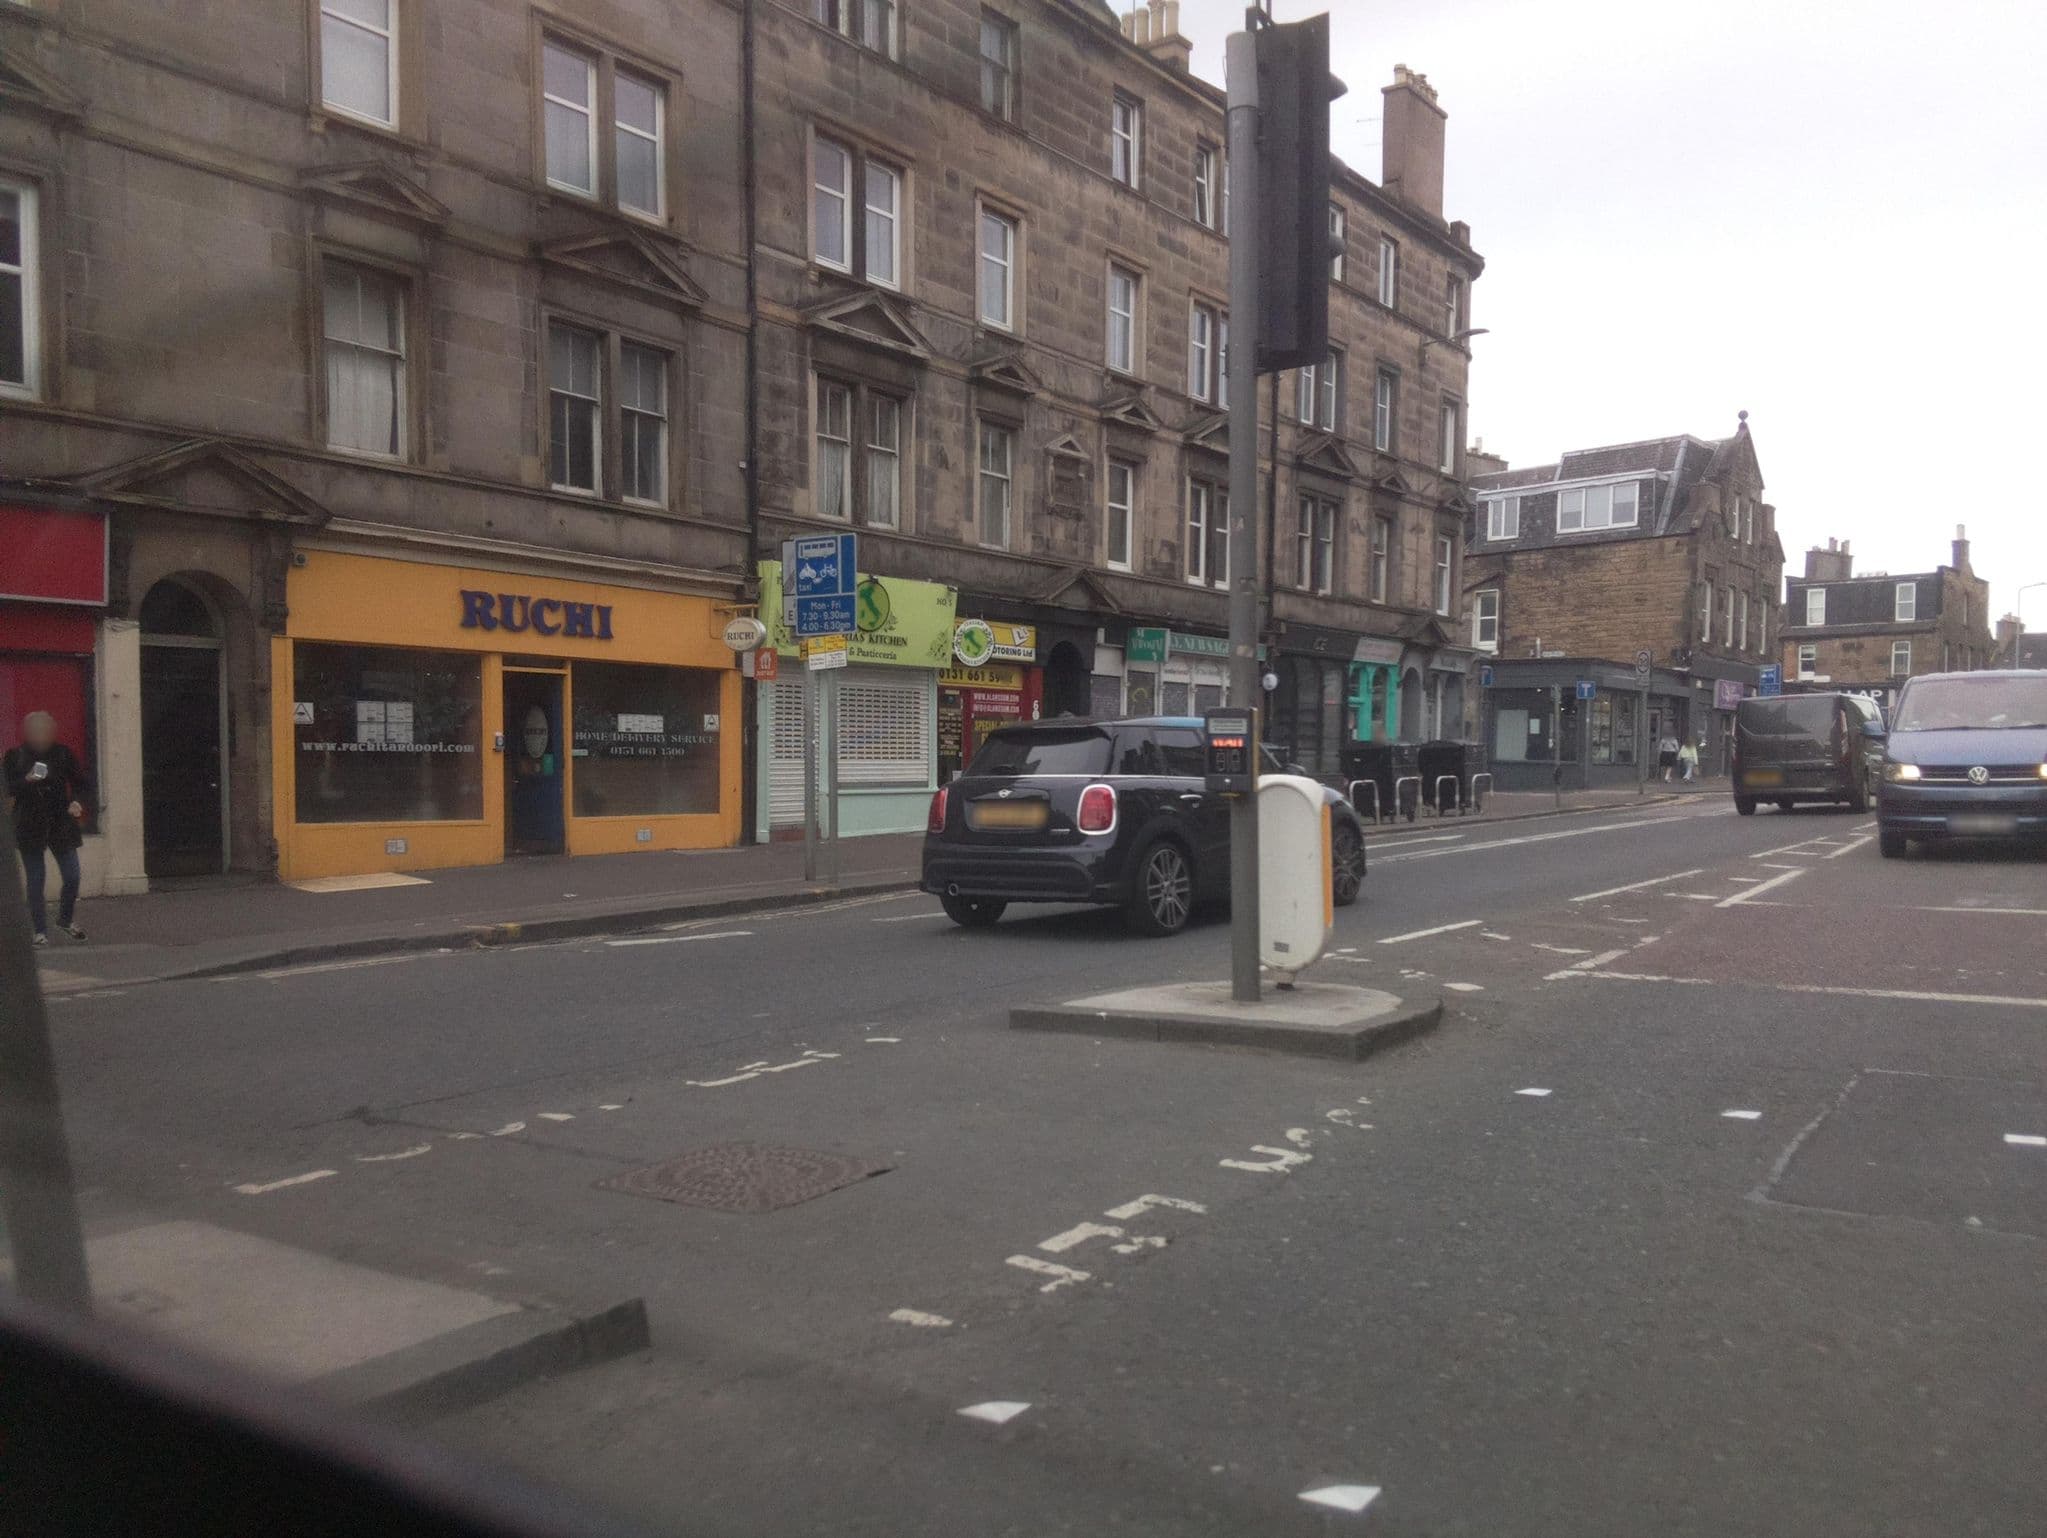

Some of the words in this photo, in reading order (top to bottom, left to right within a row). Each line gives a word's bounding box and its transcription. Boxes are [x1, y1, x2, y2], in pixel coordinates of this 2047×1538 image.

[811, 601, 827, 610] Mon
[831, 600, 841, 609] Fri
[460, 589, 614, 640] RUCHI
[727, 631, 755, 641] RUCHI
[868, 633, 909, 647] KITCHEN
[939, 668, 964, 681] 0131
[967, 669, 986, 681] 661
[575, 731, 608, 742] HOME
[612, 731, 666, 743] DELIVERY
[670, 734, 715, 744] SERVICE
[301, 740, 476, 753] www.ruchitandoori.com
